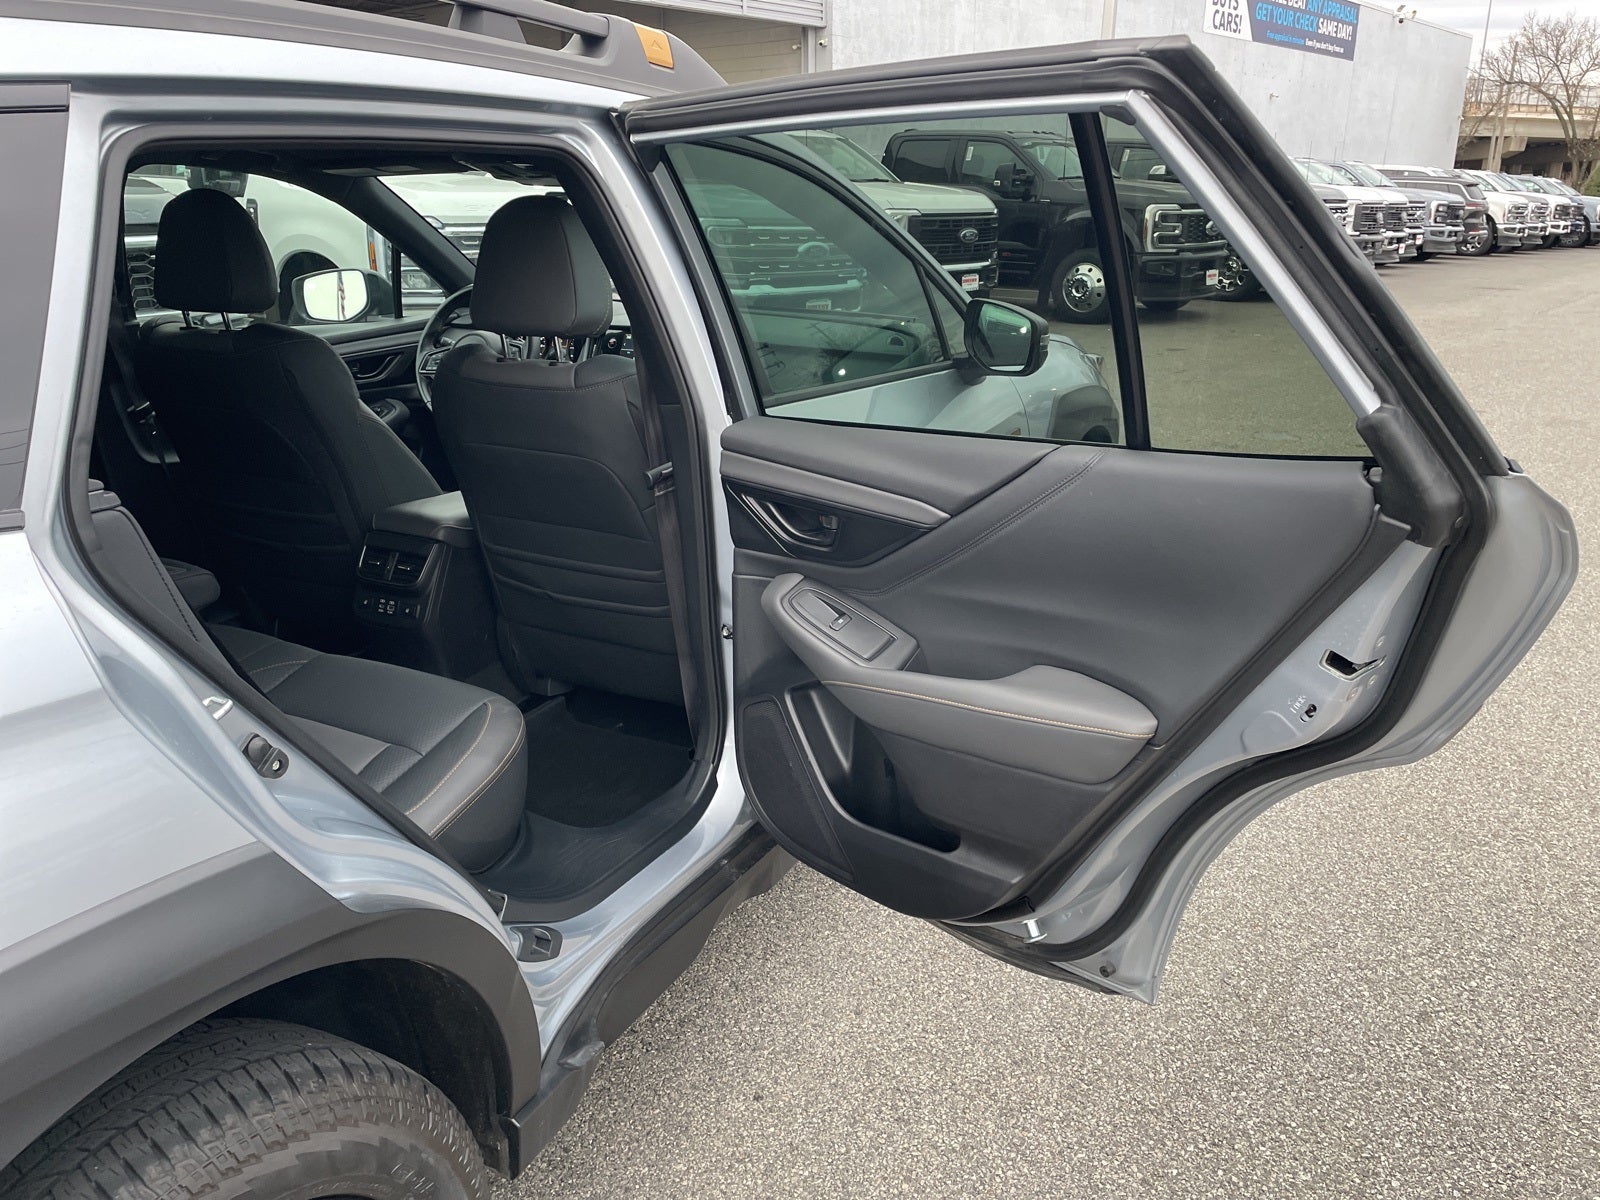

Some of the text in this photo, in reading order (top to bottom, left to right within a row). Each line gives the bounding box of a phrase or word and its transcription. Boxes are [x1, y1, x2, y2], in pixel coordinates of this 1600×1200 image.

[1213, 9, 1242, 34] CARS!
[1256, 2, 1272, 21] GET
[1272, 6, 1293, 27] YOUR
[1295, 12, 1318, 32] CHECK
[1318, 17, 1337, 37] SAME
[1307, 0, 1322, 13] ANY
[1323, 1, 1357, 24] APPRAISAL
